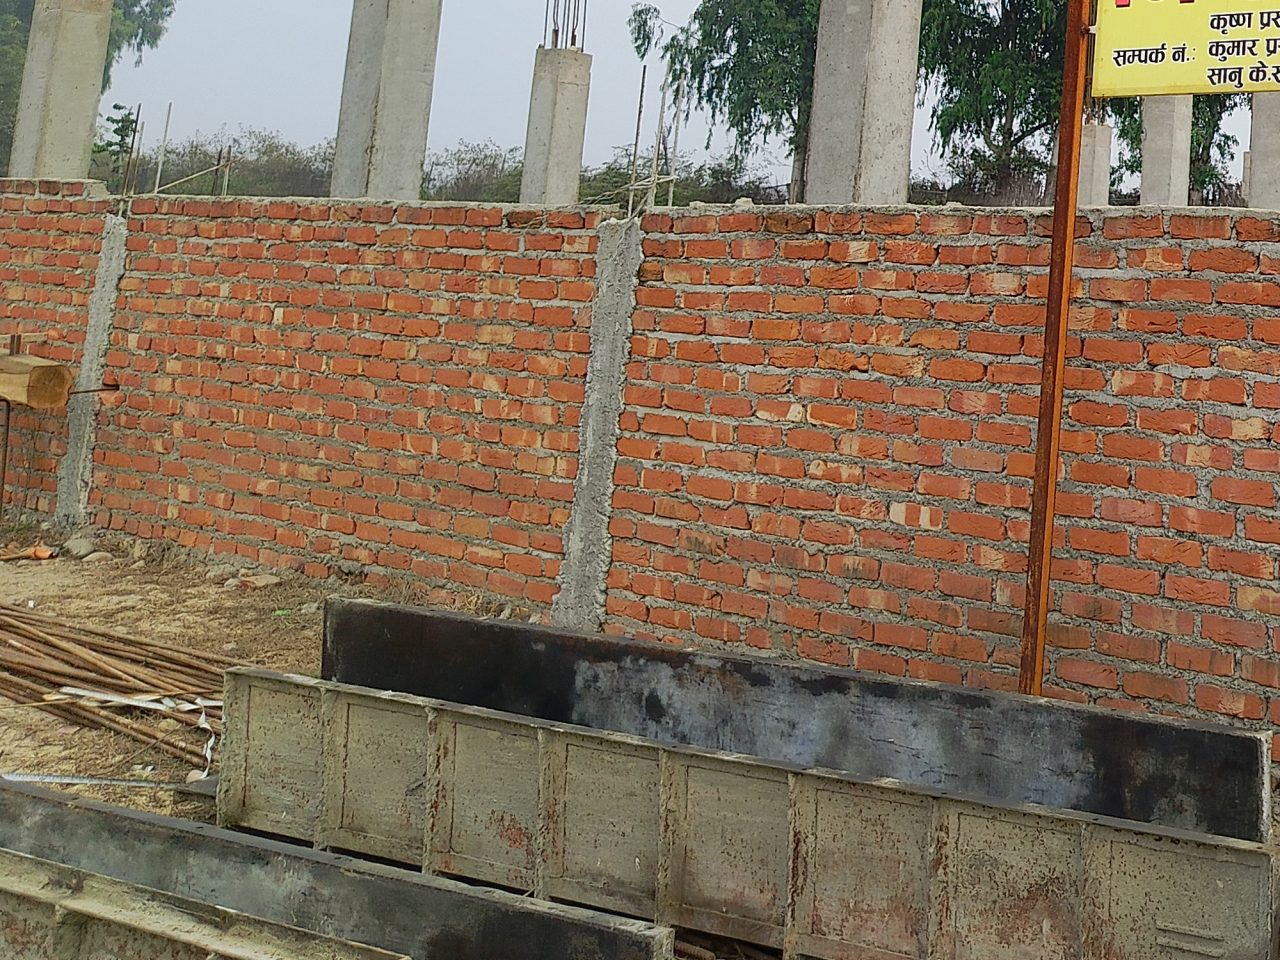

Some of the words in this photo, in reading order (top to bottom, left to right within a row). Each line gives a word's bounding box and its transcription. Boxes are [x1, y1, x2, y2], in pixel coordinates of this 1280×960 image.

[1209, 12, 1253, 34] कृष्ण
[1113, 43, 1168, 67] सम्पर्क
[1208, 39, 1260, 61] कुमार
[1207, 66, 1244, 88] सानु
